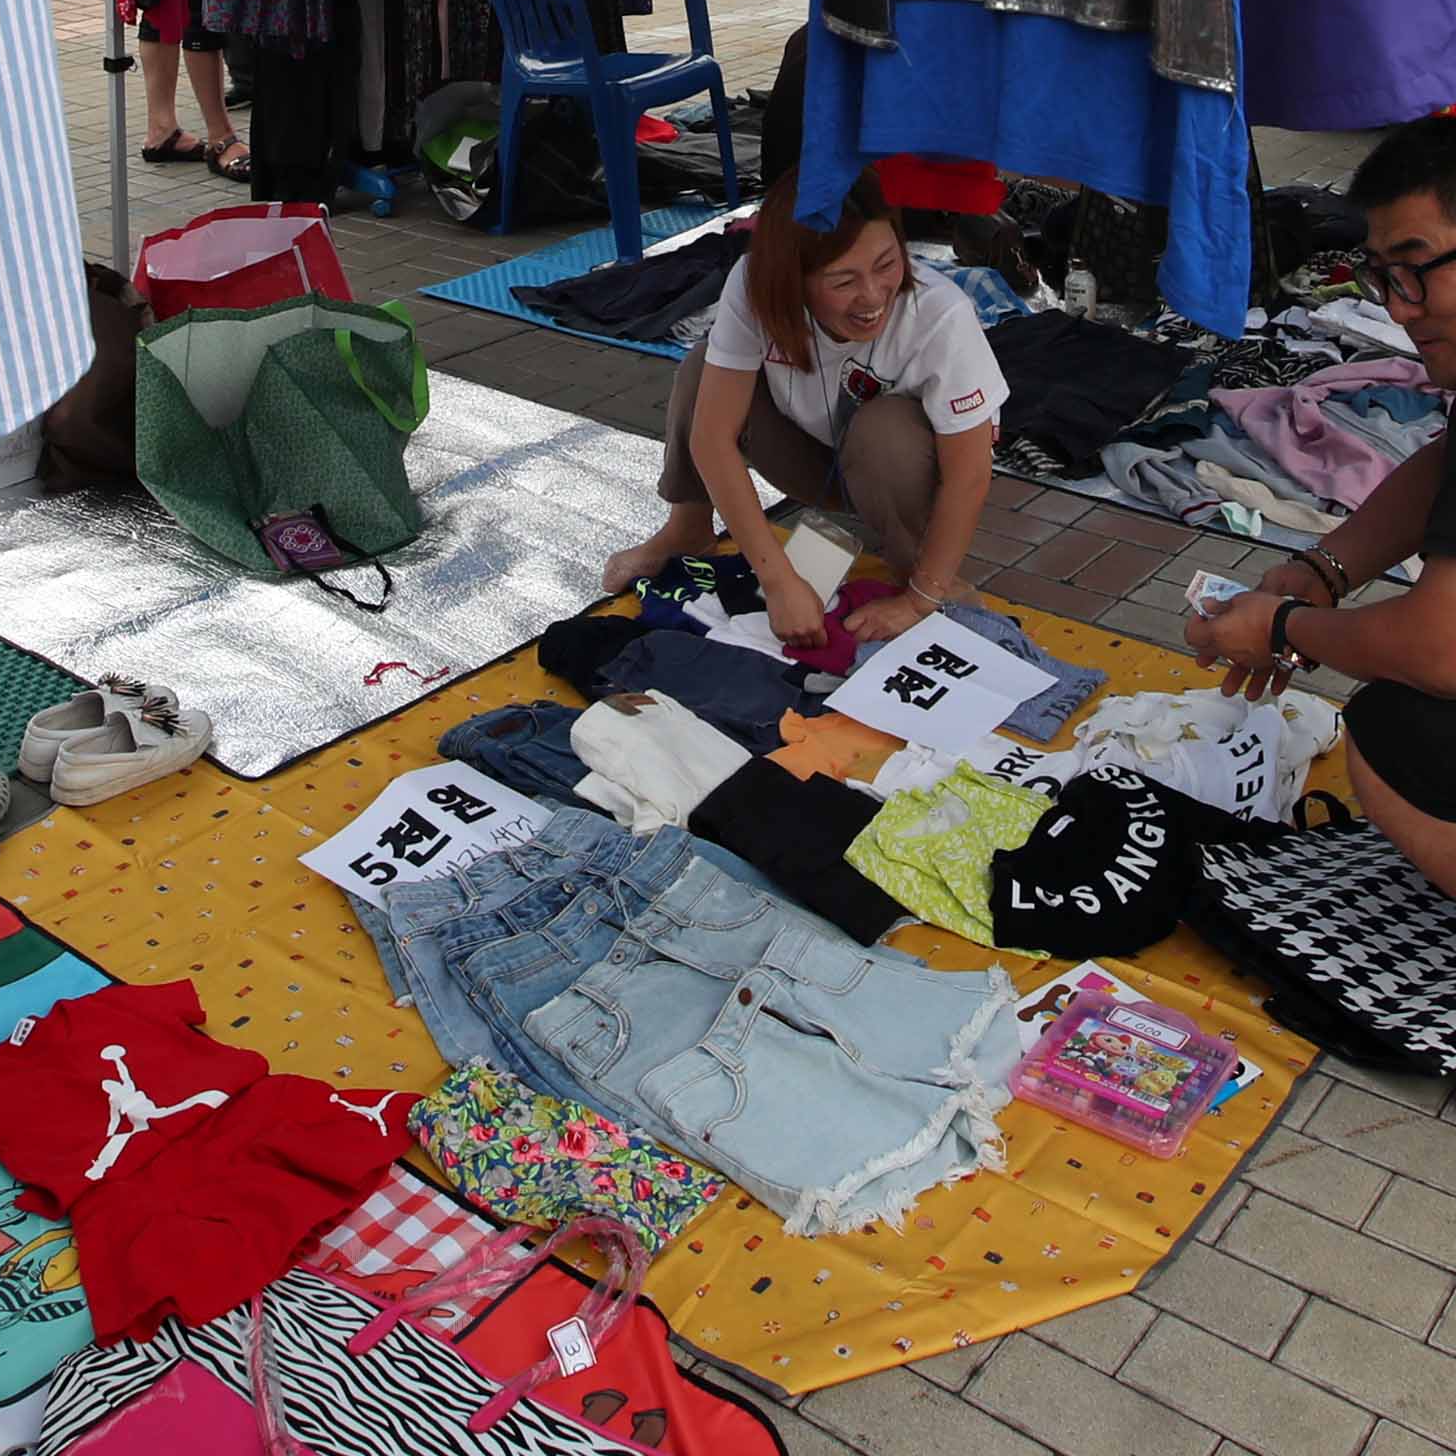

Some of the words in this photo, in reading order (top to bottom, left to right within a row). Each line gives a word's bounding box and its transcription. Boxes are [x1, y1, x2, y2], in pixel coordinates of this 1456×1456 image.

[954, 393, 984, 414] MARVEL
[882, 643, 979, 711] 천원
[348, 783, 497, 886] 5천원
